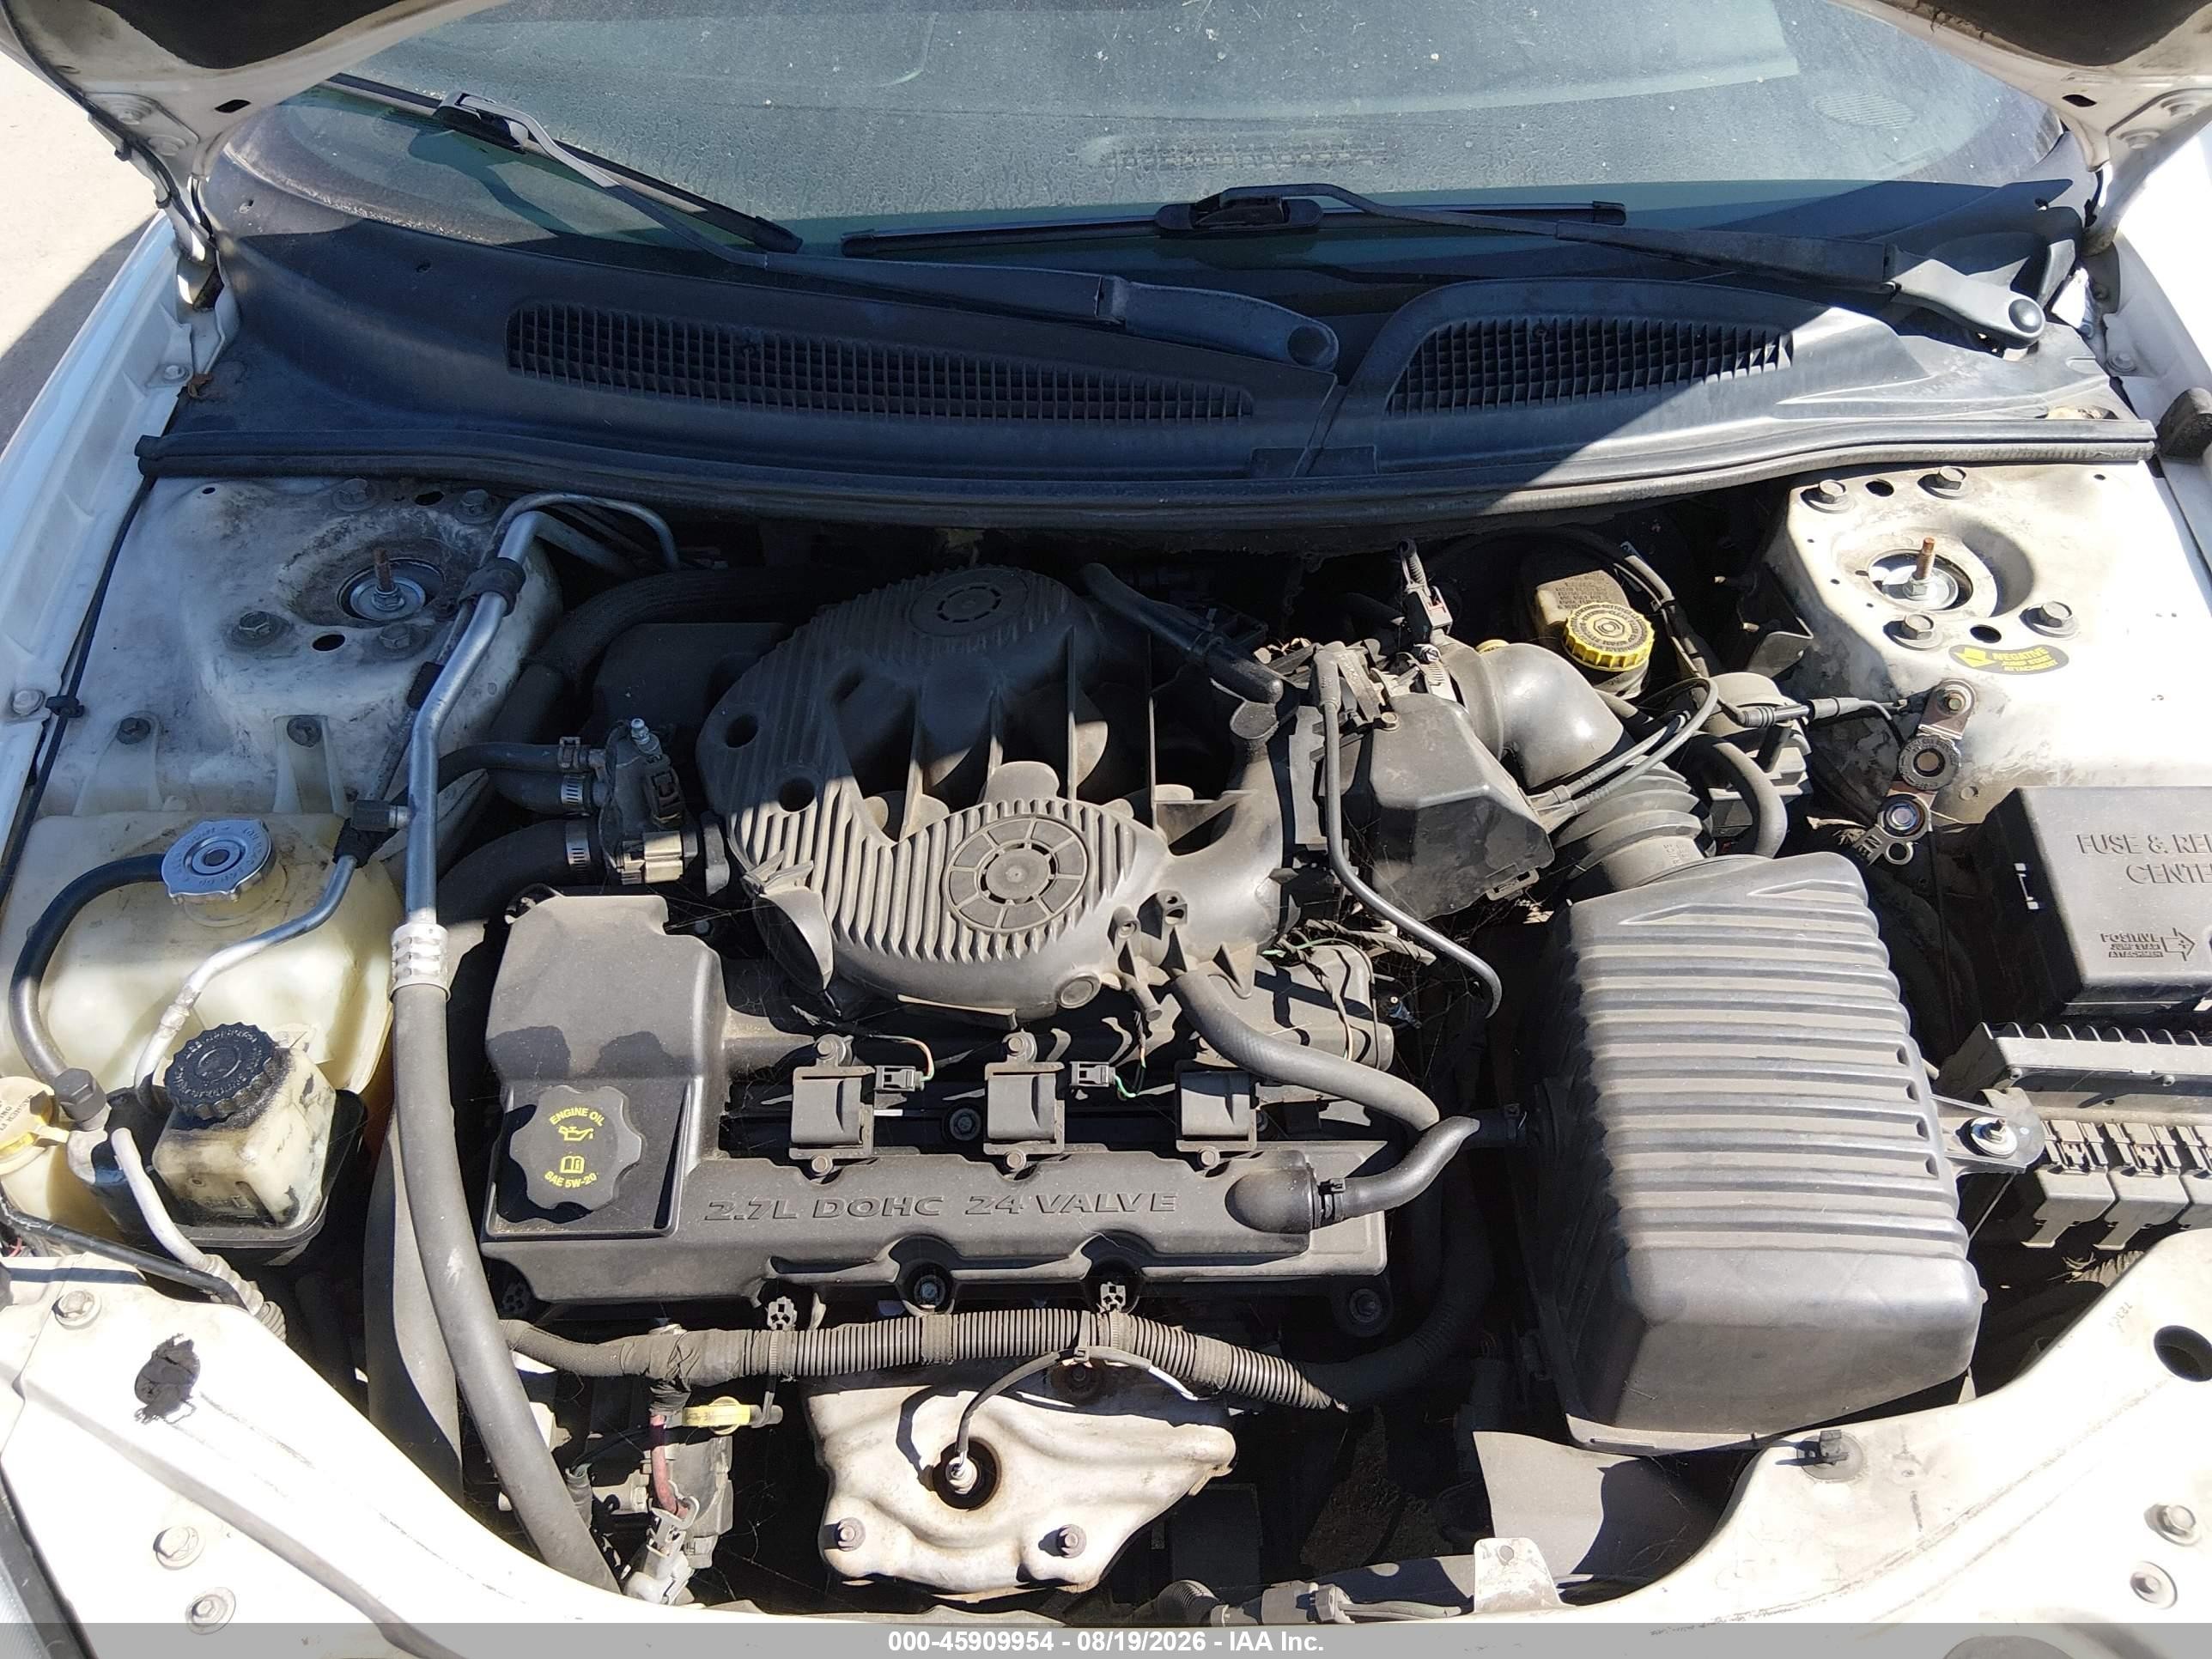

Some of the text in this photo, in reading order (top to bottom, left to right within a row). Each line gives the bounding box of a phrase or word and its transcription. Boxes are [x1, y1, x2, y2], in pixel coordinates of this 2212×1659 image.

[1991, 647, 2050, 661] NEGATIVE
[2076, 834, 2144, 854] FUSE
[2148, 834, 2169, 854] &
[2126, 863, 2212, 884] CENTE
[2100, 933, 2160, 943] POSITIVE
[549, 1107, 605, 1127] ENGINE OIL
[544, 1170, 599, 1188] SAE 5W-20
[703, 1191, 1178, 1222] 2.7L DOHC 24 VALVE
